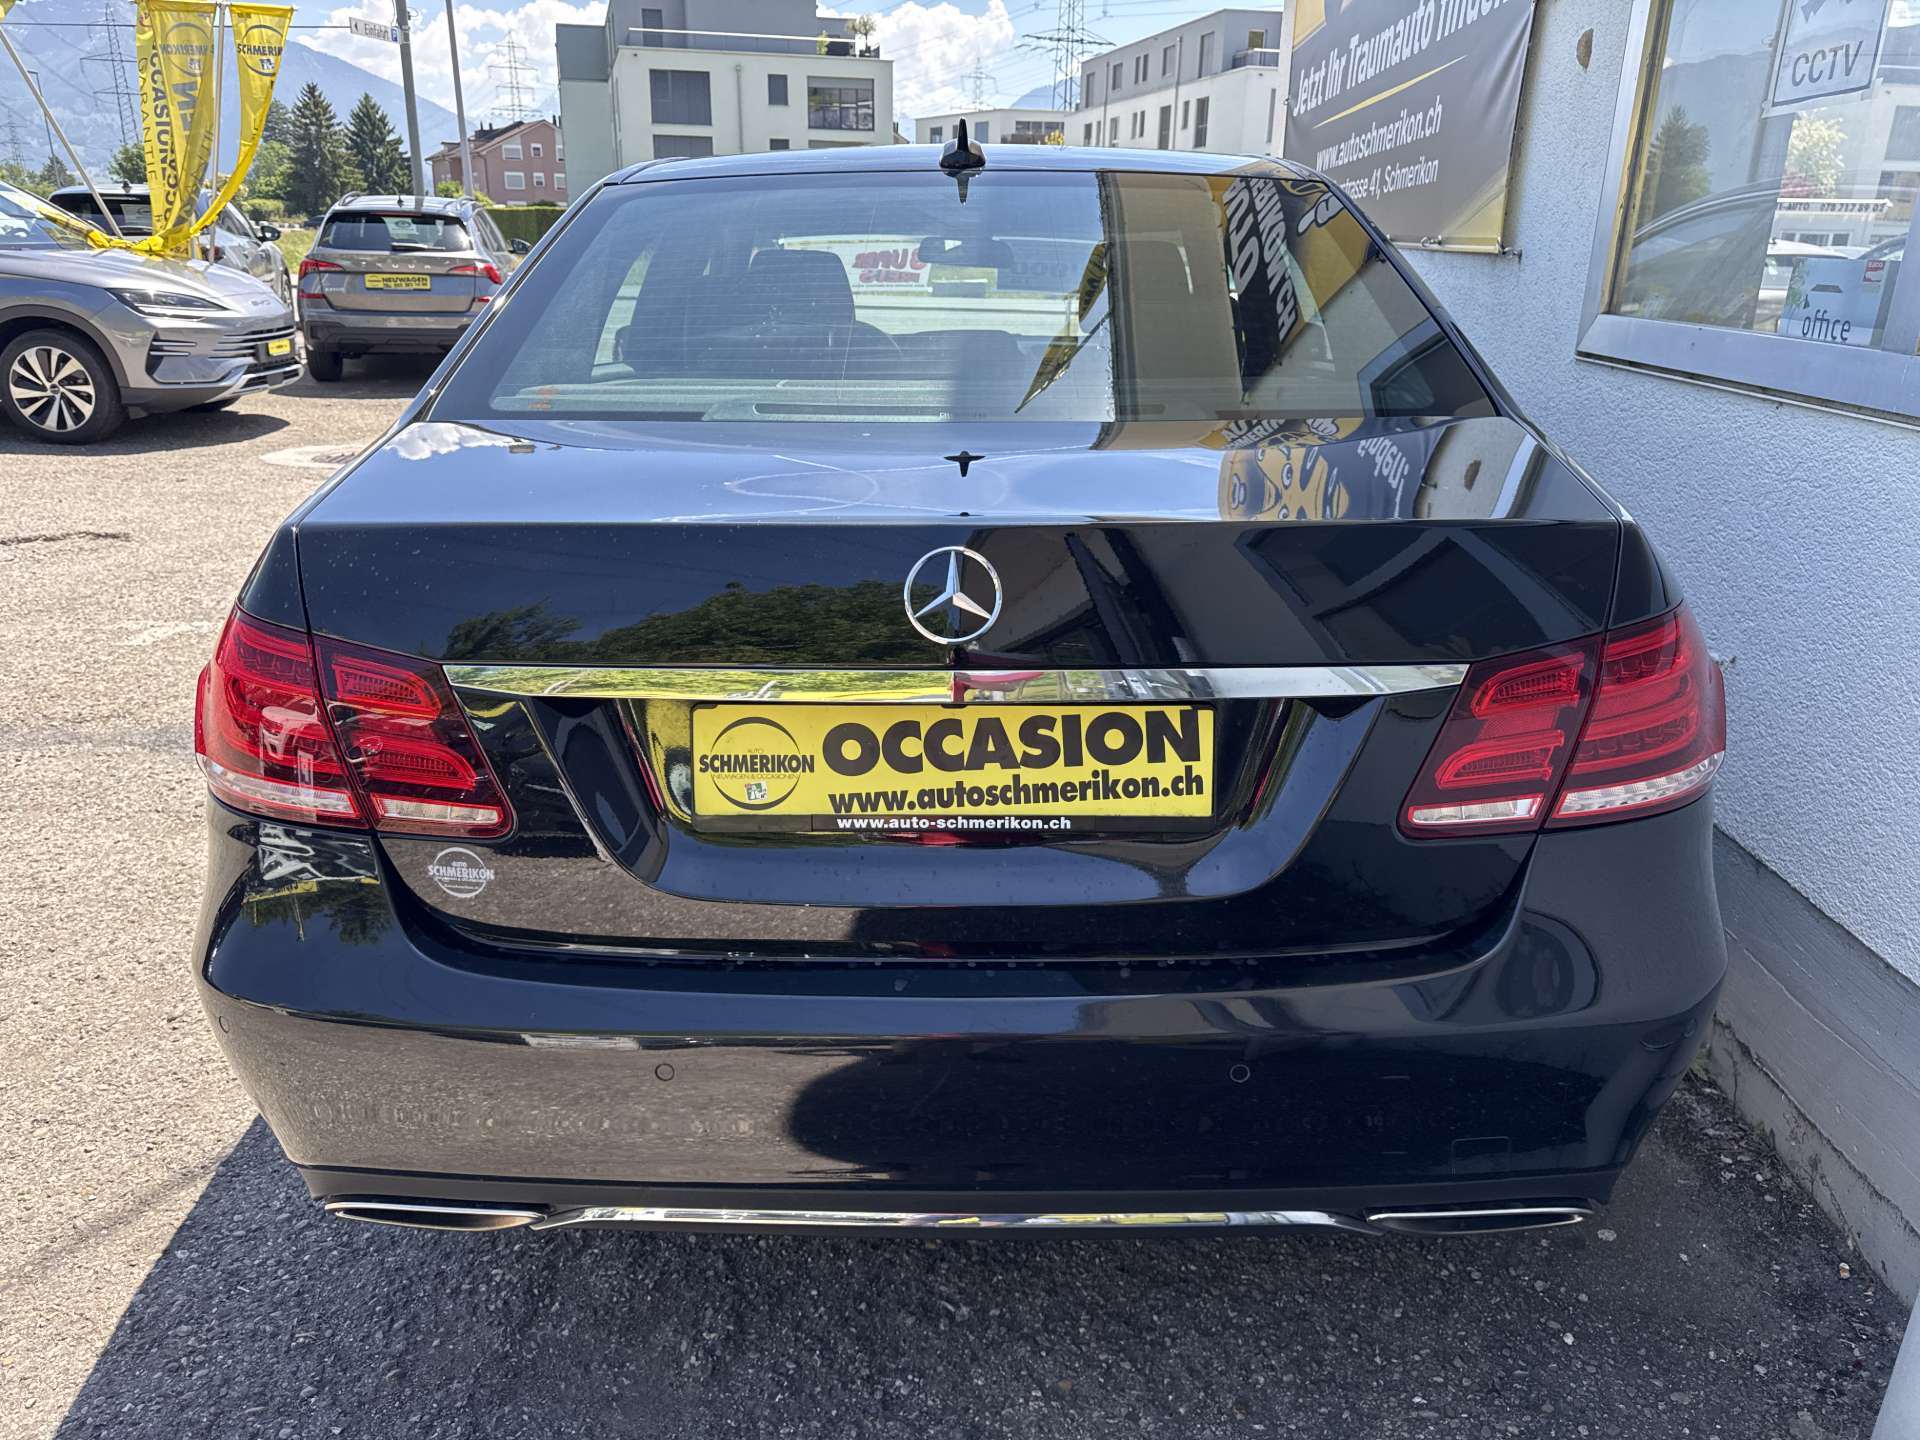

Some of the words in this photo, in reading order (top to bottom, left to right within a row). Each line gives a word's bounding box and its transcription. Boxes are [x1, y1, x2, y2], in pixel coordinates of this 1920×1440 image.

[1293, 60, 1328, 117] Jetzt
[1325, 48, 1346, 102] Ihr
[1346, 0, 1434, 91] Traumauto
[1791, 40, 1864, 87] CCTV
[1316, 95, 1443, 172] www.autoschmerikon.ch
[1383, 156, 1439, 193] Schmerikon
[1801, 309, 1851, 341] office
[699, 754, 815, 773] SCHMERIKON
[822, 709, 1201, 777] OCCASION
[828, 765, 1205, 815] www.autoschmerikon.ch
[836, 815, 1072, 831] www.auto-schmerikon.ch
[427, 864, 496, 881] SCHMERIKON
